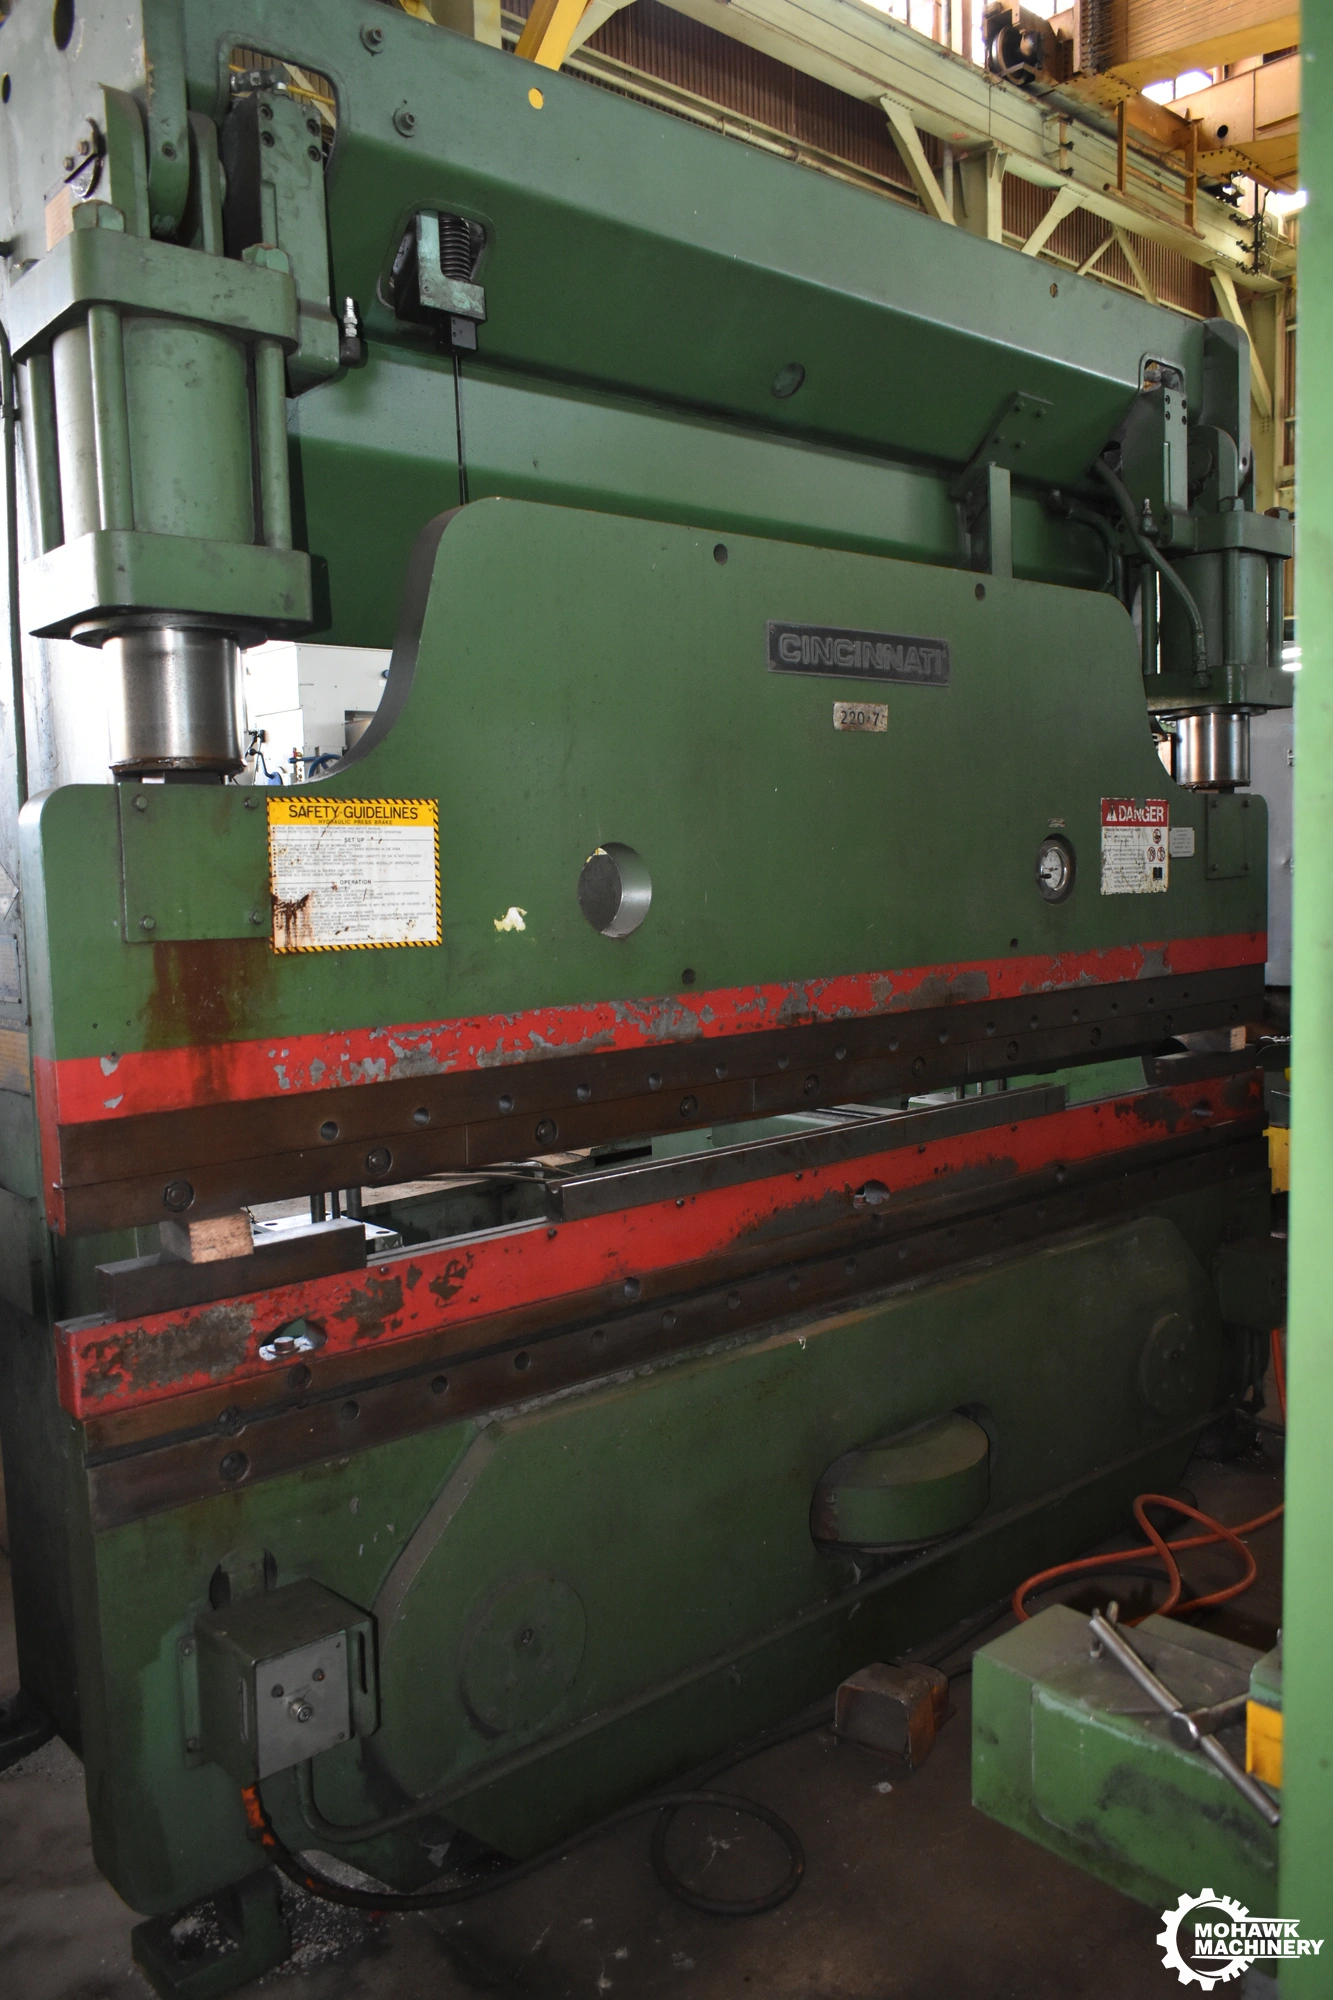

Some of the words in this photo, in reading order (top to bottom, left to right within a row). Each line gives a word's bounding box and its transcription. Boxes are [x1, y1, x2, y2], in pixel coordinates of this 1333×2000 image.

[779, 633, 942, 675] CINCINNATI
[288, 804, 340, 819] SAFETY
[343, 805, 419, 820] GUIDELINES
[1118, 805, 1164, 822] DANGER
